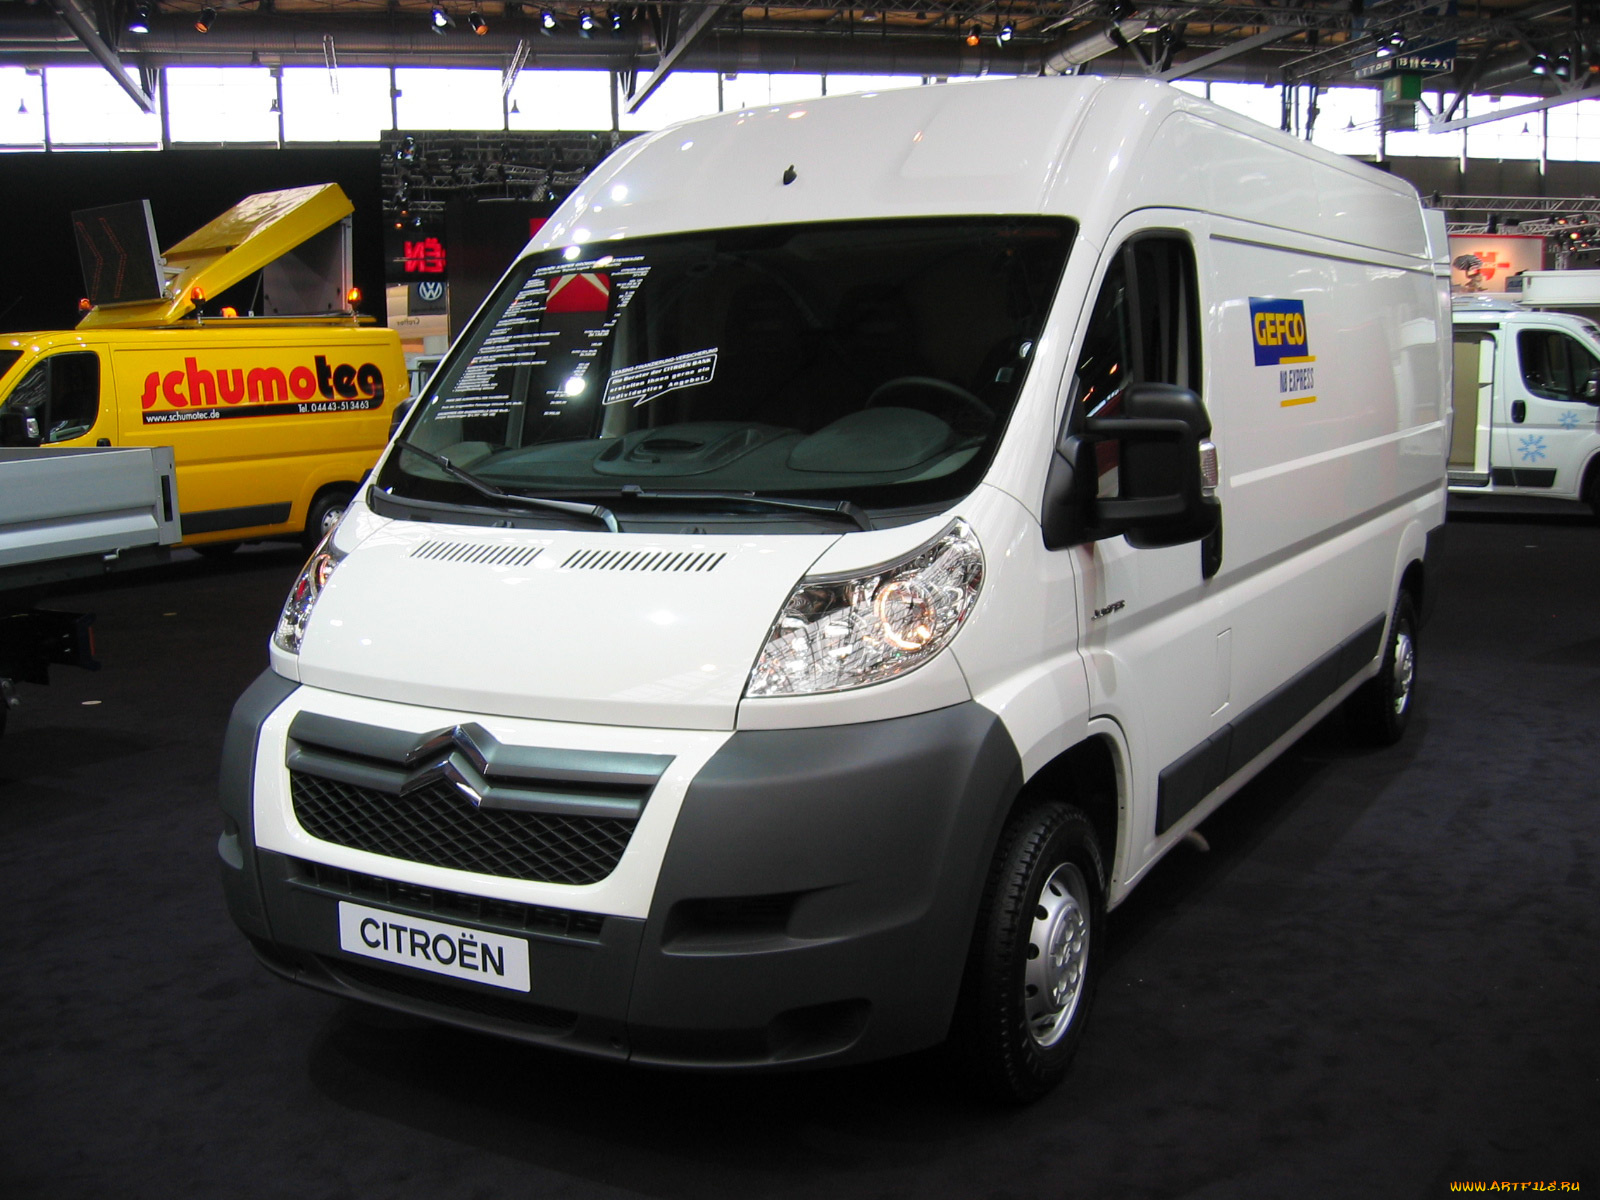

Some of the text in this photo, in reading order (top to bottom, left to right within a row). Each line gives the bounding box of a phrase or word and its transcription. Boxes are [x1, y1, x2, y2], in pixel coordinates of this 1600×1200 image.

[1254, 312, 1306, 346] GEFCO
[1288, 367, 1314, 392] EXPRESS
[146, 408, 220, 423] www.schumotec.de
[298, 403, 310, 413] Tel.
[360, 917, 505, 976] CITROËN
